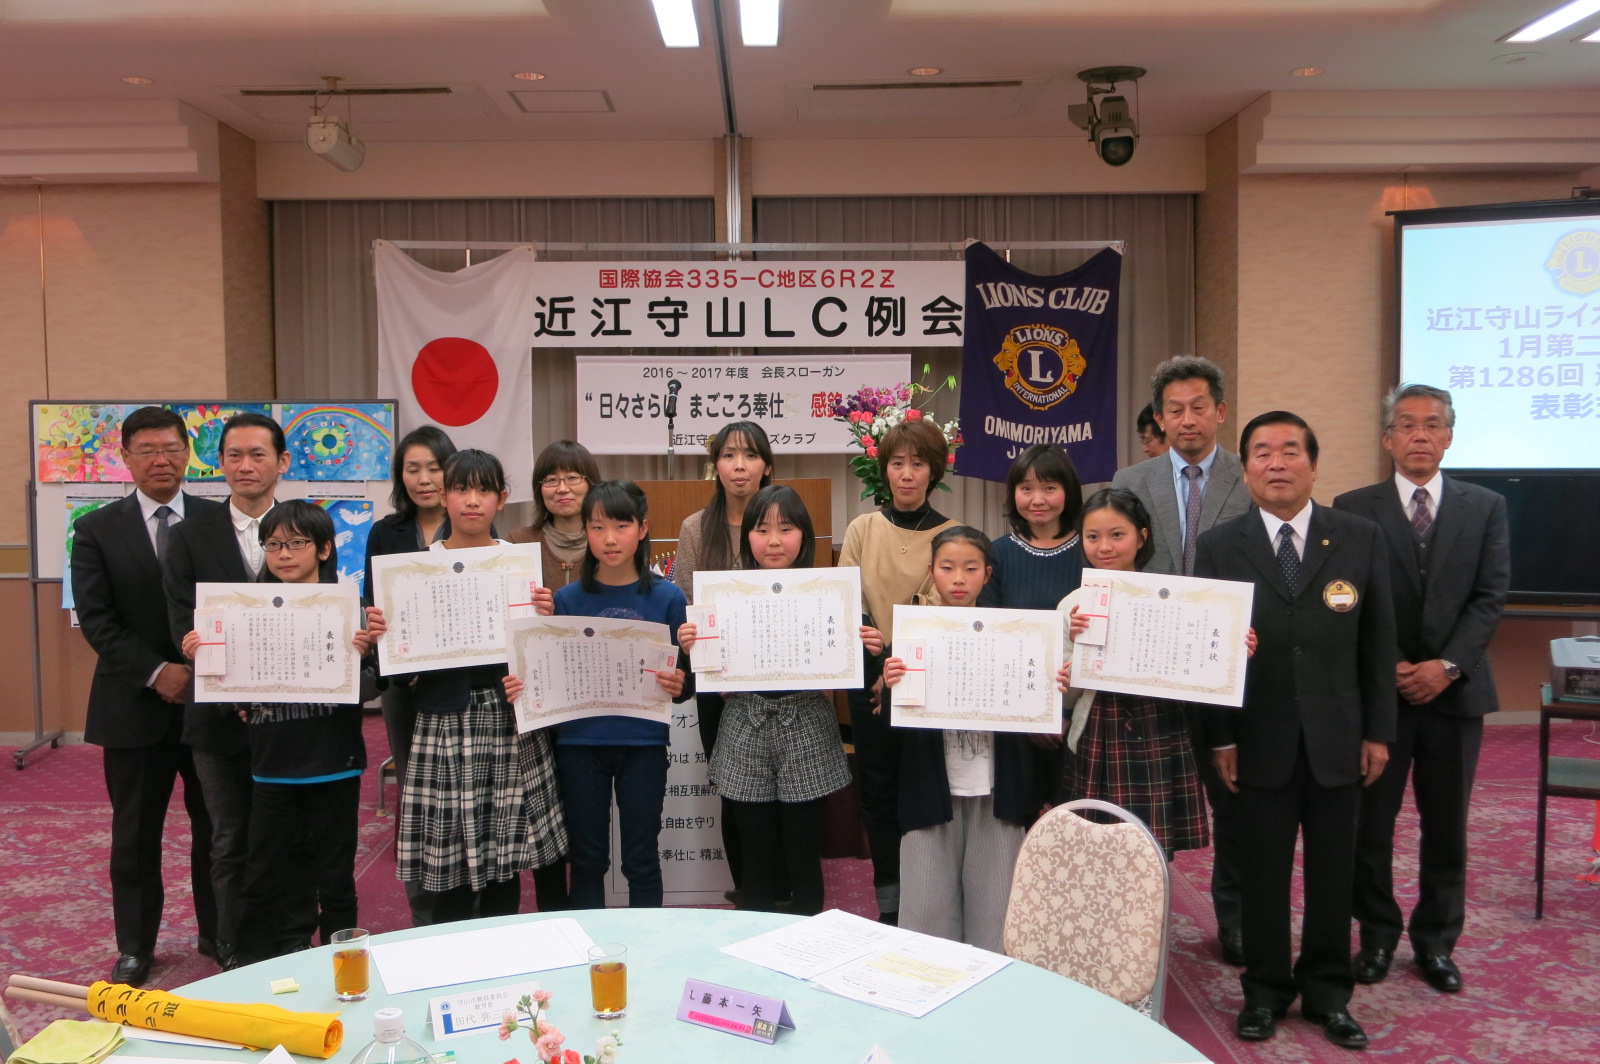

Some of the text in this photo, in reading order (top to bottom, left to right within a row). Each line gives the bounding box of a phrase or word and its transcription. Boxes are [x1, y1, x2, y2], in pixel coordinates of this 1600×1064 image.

[976, 281, 1110, 315] LIONS CLUB
[533, 295, 963, 338] 近江守山LC例会
[1015, 328, 1064, 346] LIONS
[761, 366, 845, 379] 会長スローガン
[1027, 350, 1054, 383] L
[1448, 363, 1584, 389] 第1286回
[690, 392, 785, 419] まごころ奉仕
[1013, 381, 1068, 404] INTERNATIONAL
[1529, 392, 1600, 420] 表彰
